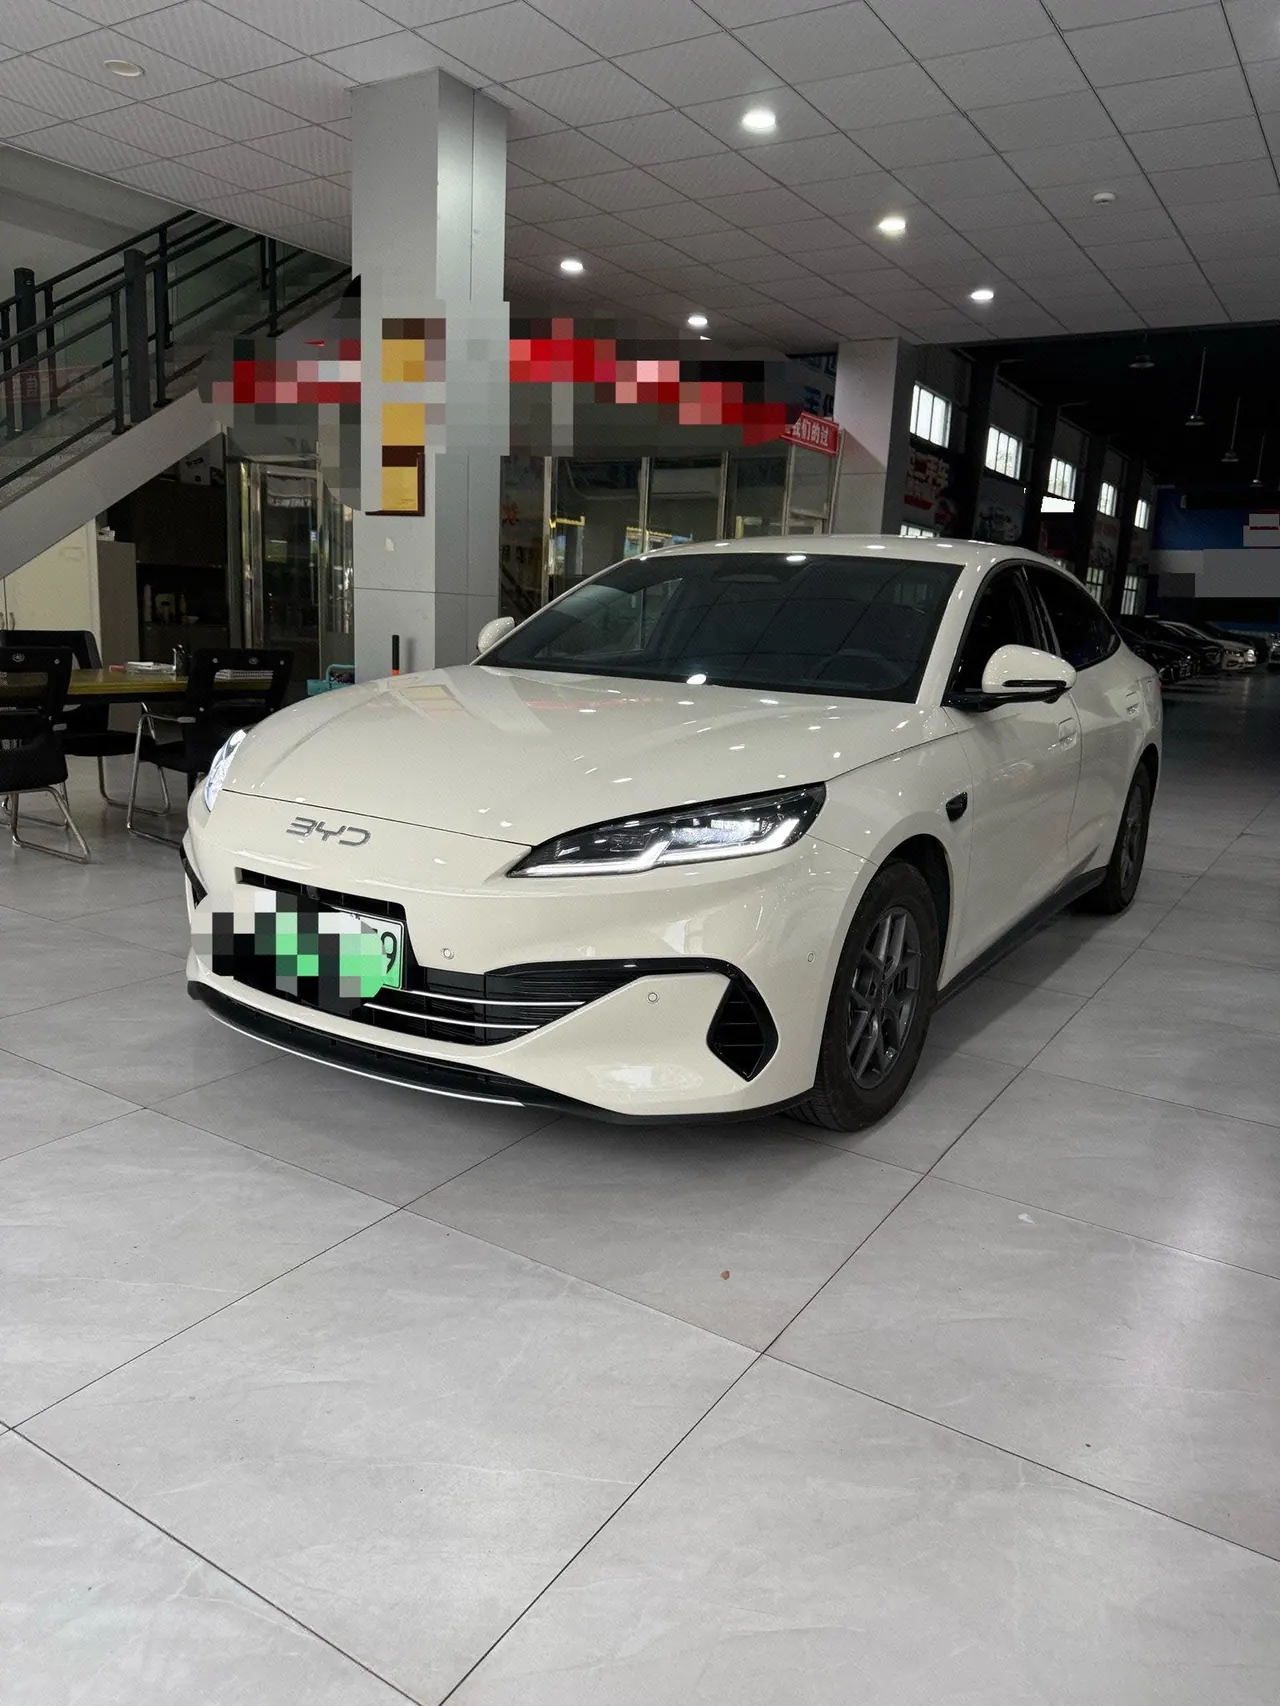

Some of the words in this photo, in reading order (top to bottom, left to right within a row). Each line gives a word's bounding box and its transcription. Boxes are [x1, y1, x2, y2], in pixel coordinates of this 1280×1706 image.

[786, 418, 829, 447] 我们的过
[285, 816, 371, 847] BYD
